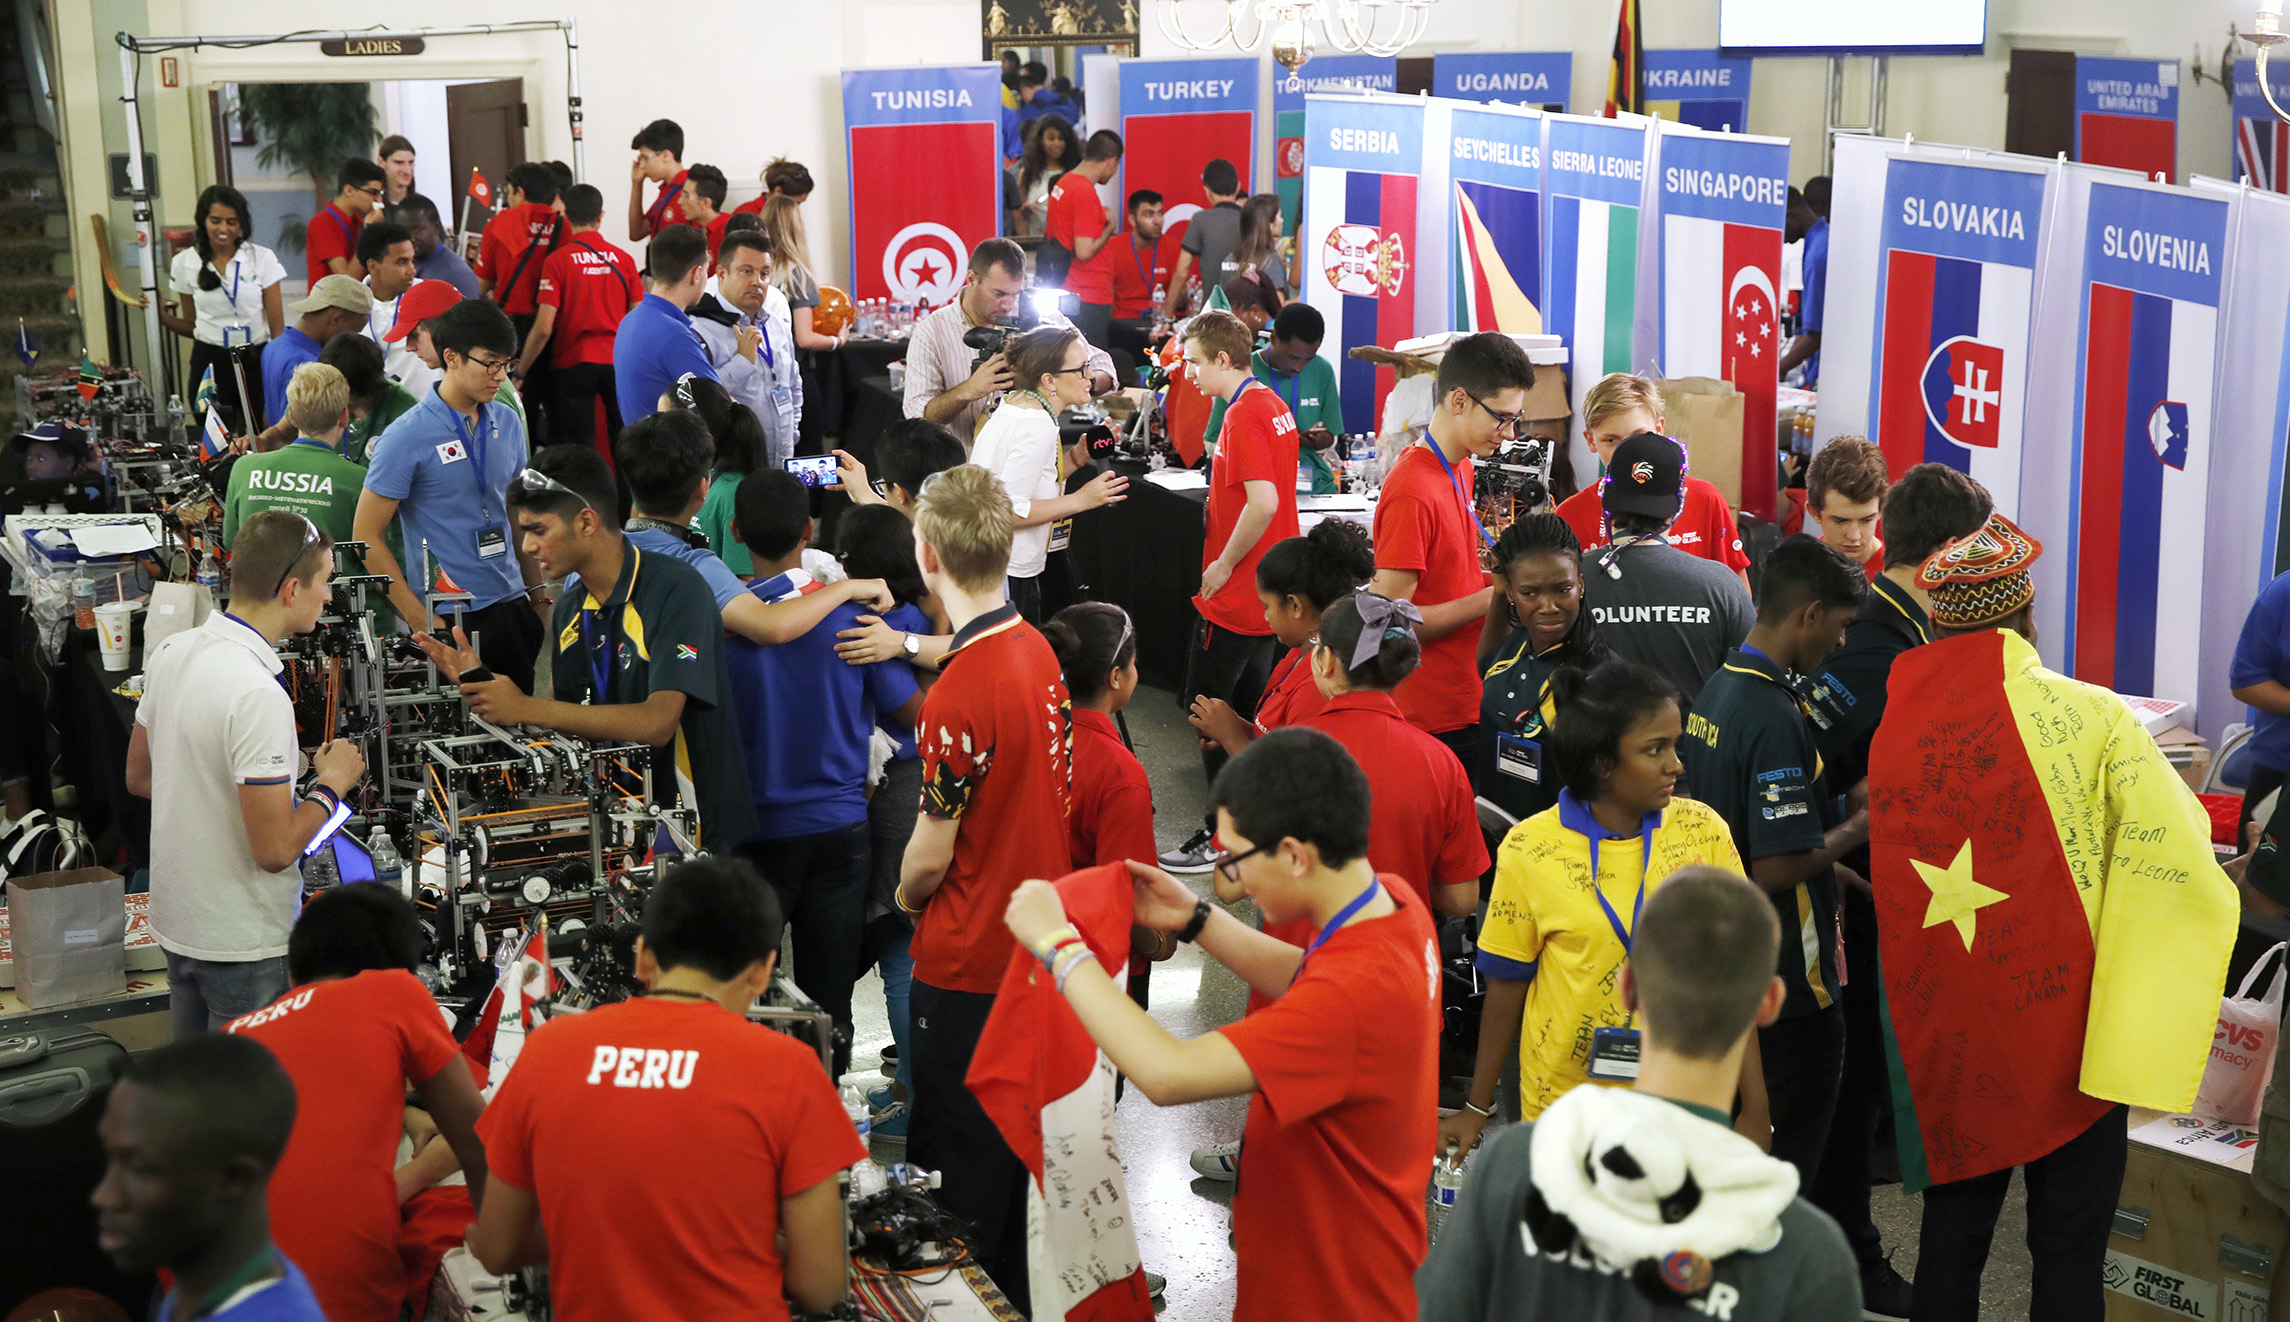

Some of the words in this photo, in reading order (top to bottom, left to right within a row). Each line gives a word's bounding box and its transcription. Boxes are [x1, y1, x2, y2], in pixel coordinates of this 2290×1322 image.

[345, 40, 402, 54] LADIES
[1145, 79, 1234, 100] TURKEY
[1456, 73, 1549, 92] UGANDA
[2087, 79, 2132, 97] UNITED
[2135, 82, 2170, 100] ARAB
[871, 88, 973, 110] TUNISIA
[2098, 95, 2159, 114] EMIRATES
[1330, 127, 1399, 154] SERBIA
[1454, 136, 1540, 169] SEYCHELLES
[1552, 150, 1596, 175] SIERRA
[1599, 156, 1642, 181] LEONE
[1665, 167, 1785, 206] SINGAPORE
[1902, 196, 2025, 241] SLOVAKIA
[2103, 224, 2211, 276] SLOVENIA
[248, 469, 333, 496] RUSSIA
[1591, 606, 1711, 624] OLUNTEER
[1822, 672, 1857, 706] FESTO
[1686, 712, 1707, 740] SOUTH
[1757, 767, 1802, 784] FESTO
[2119, 821, 2167, 844] Team
[2132, 858, 2190, 885] Leone
[2010, 961, 2071, 991] TEAM
[227, 986, 317, 1035] PERU
[2014, 983, 2069, 1012] CANADA
[2214, 1018, 2264, 1052] CVS
[586, 1045, 700, 1090] PERU
[2174, 1128, 2217, 1146] Africa
[2134, 1265, 2185, 1293] FIRST
[2133, 1281, 2205, 1318] GLOBAL
